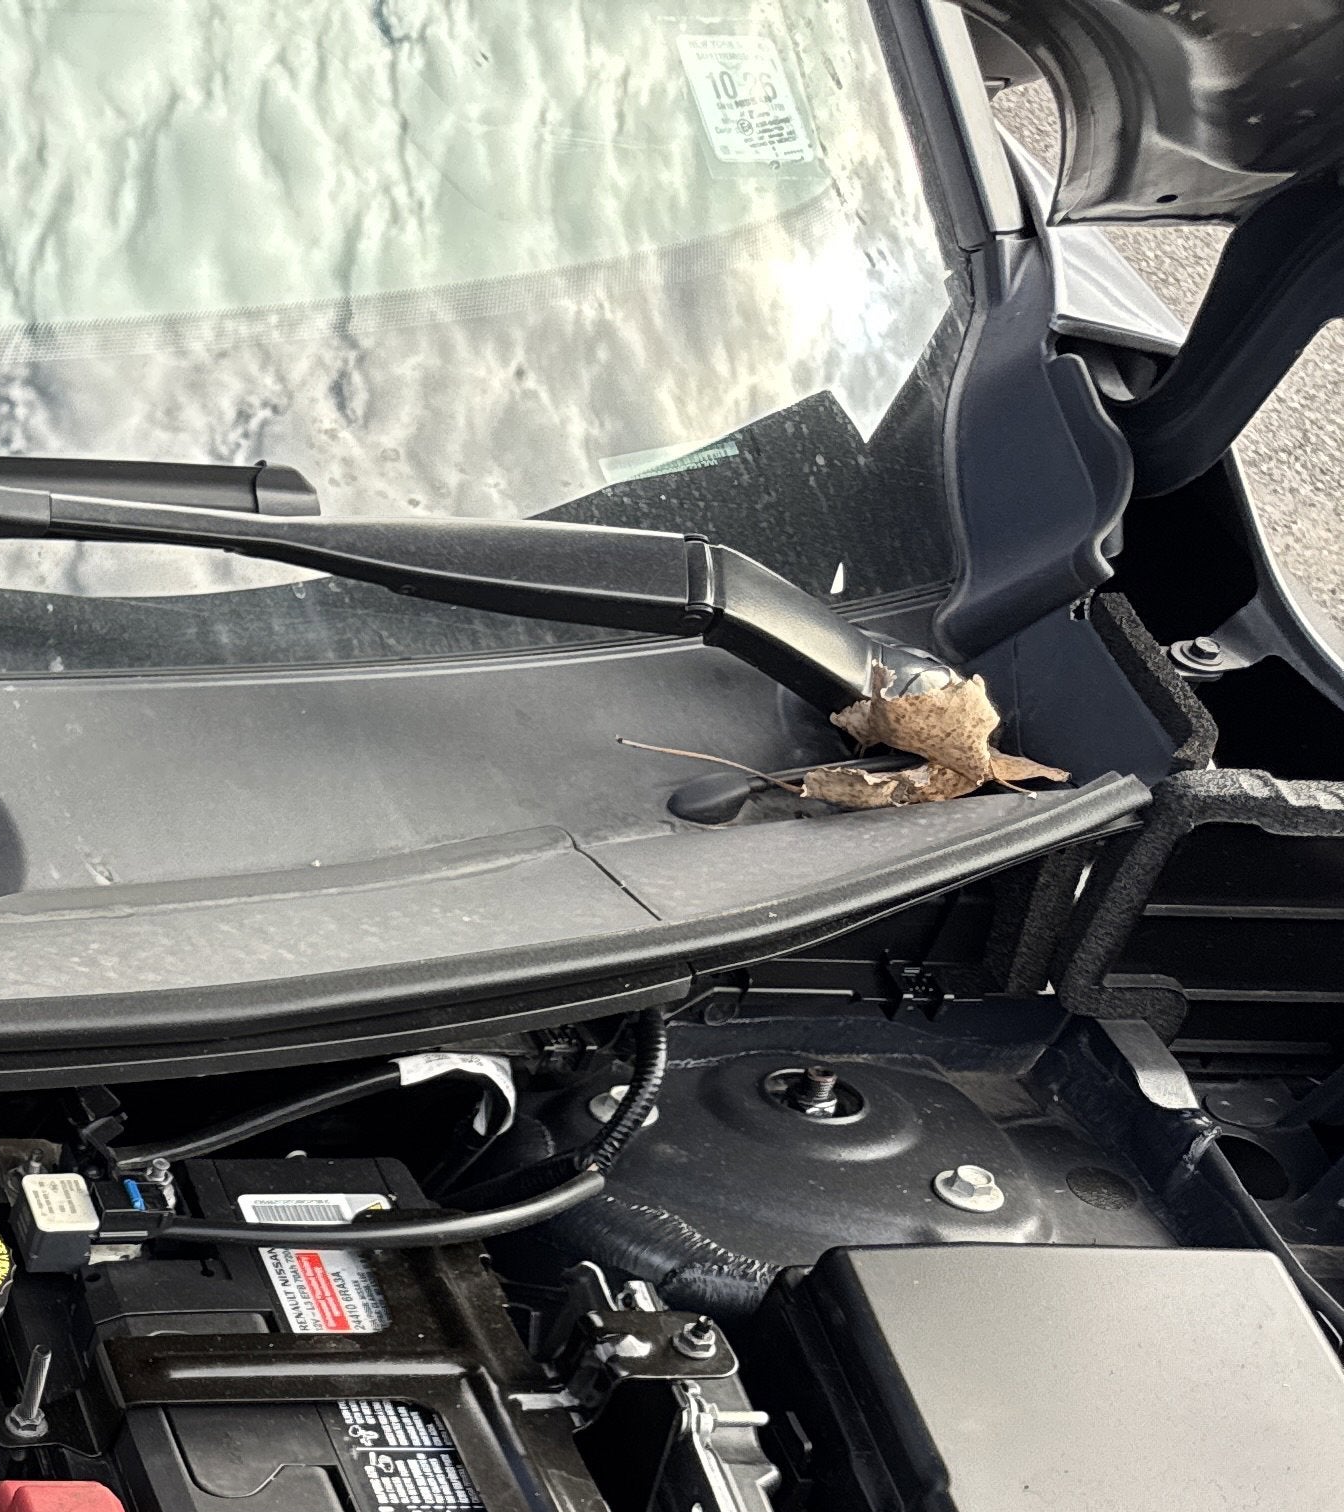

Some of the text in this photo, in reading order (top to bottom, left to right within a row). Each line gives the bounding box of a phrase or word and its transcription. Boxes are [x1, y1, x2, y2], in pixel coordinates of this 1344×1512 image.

[706, 70, 738, 100] 10
[268, 1248, 308, 1329] RENAULT NISSAN
